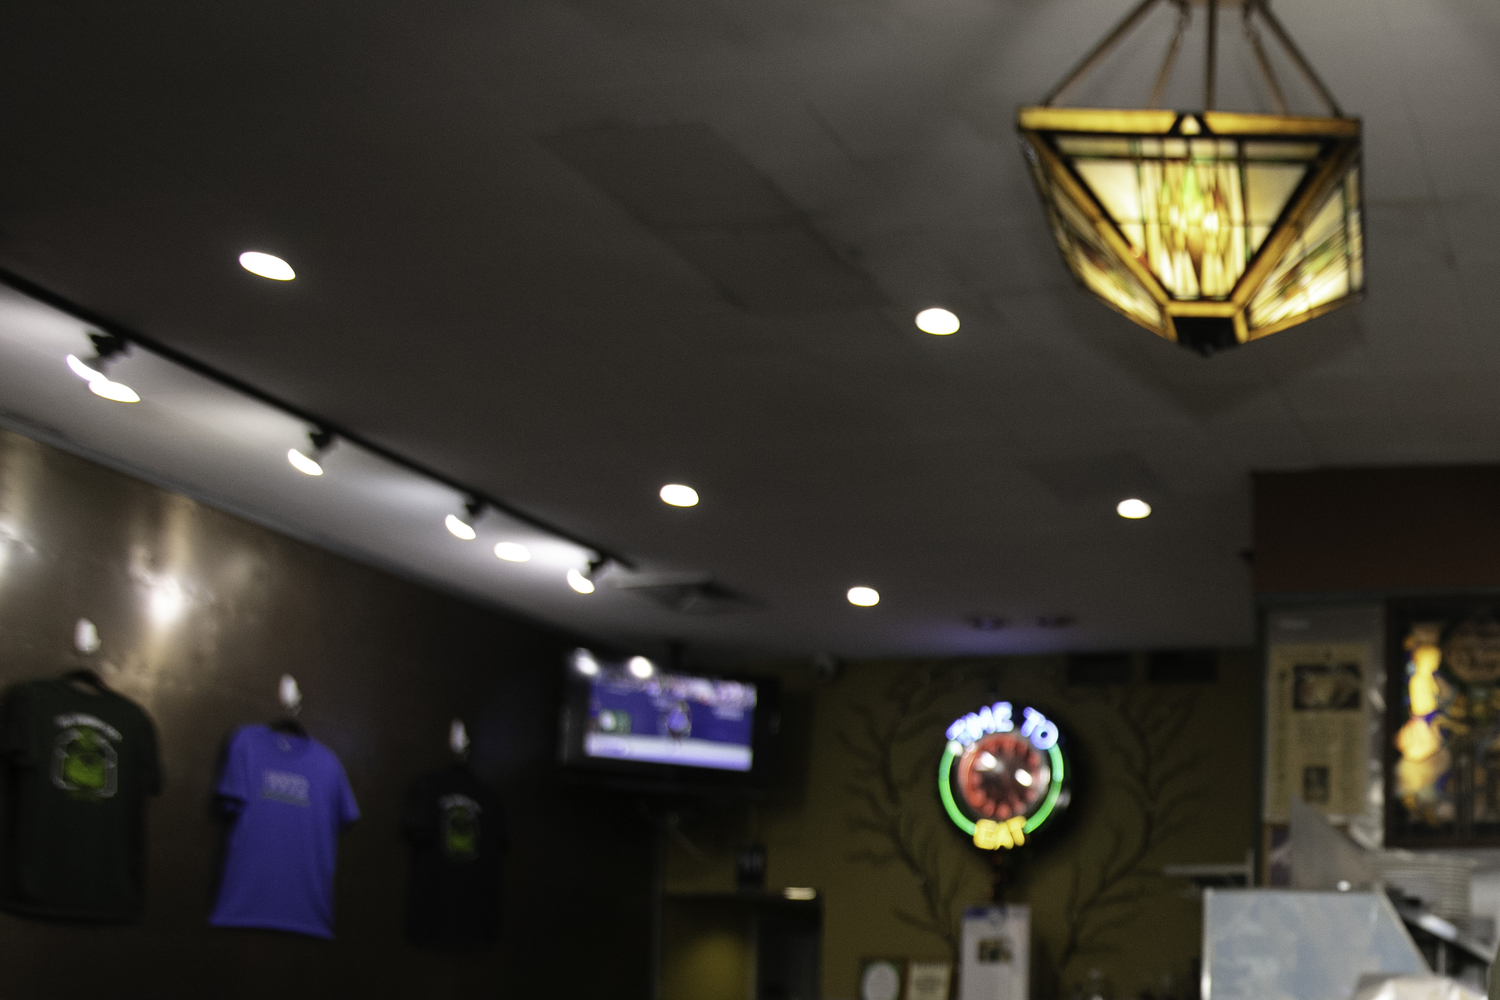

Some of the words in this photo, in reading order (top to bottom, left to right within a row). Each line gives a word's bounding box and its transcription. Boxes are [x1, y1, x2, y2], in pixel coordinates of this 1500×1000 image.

[945, 701, 1014, 746] TIME
[1020, 706, 1059, 750] TO
[973, 815, 1027, 851] EAT
